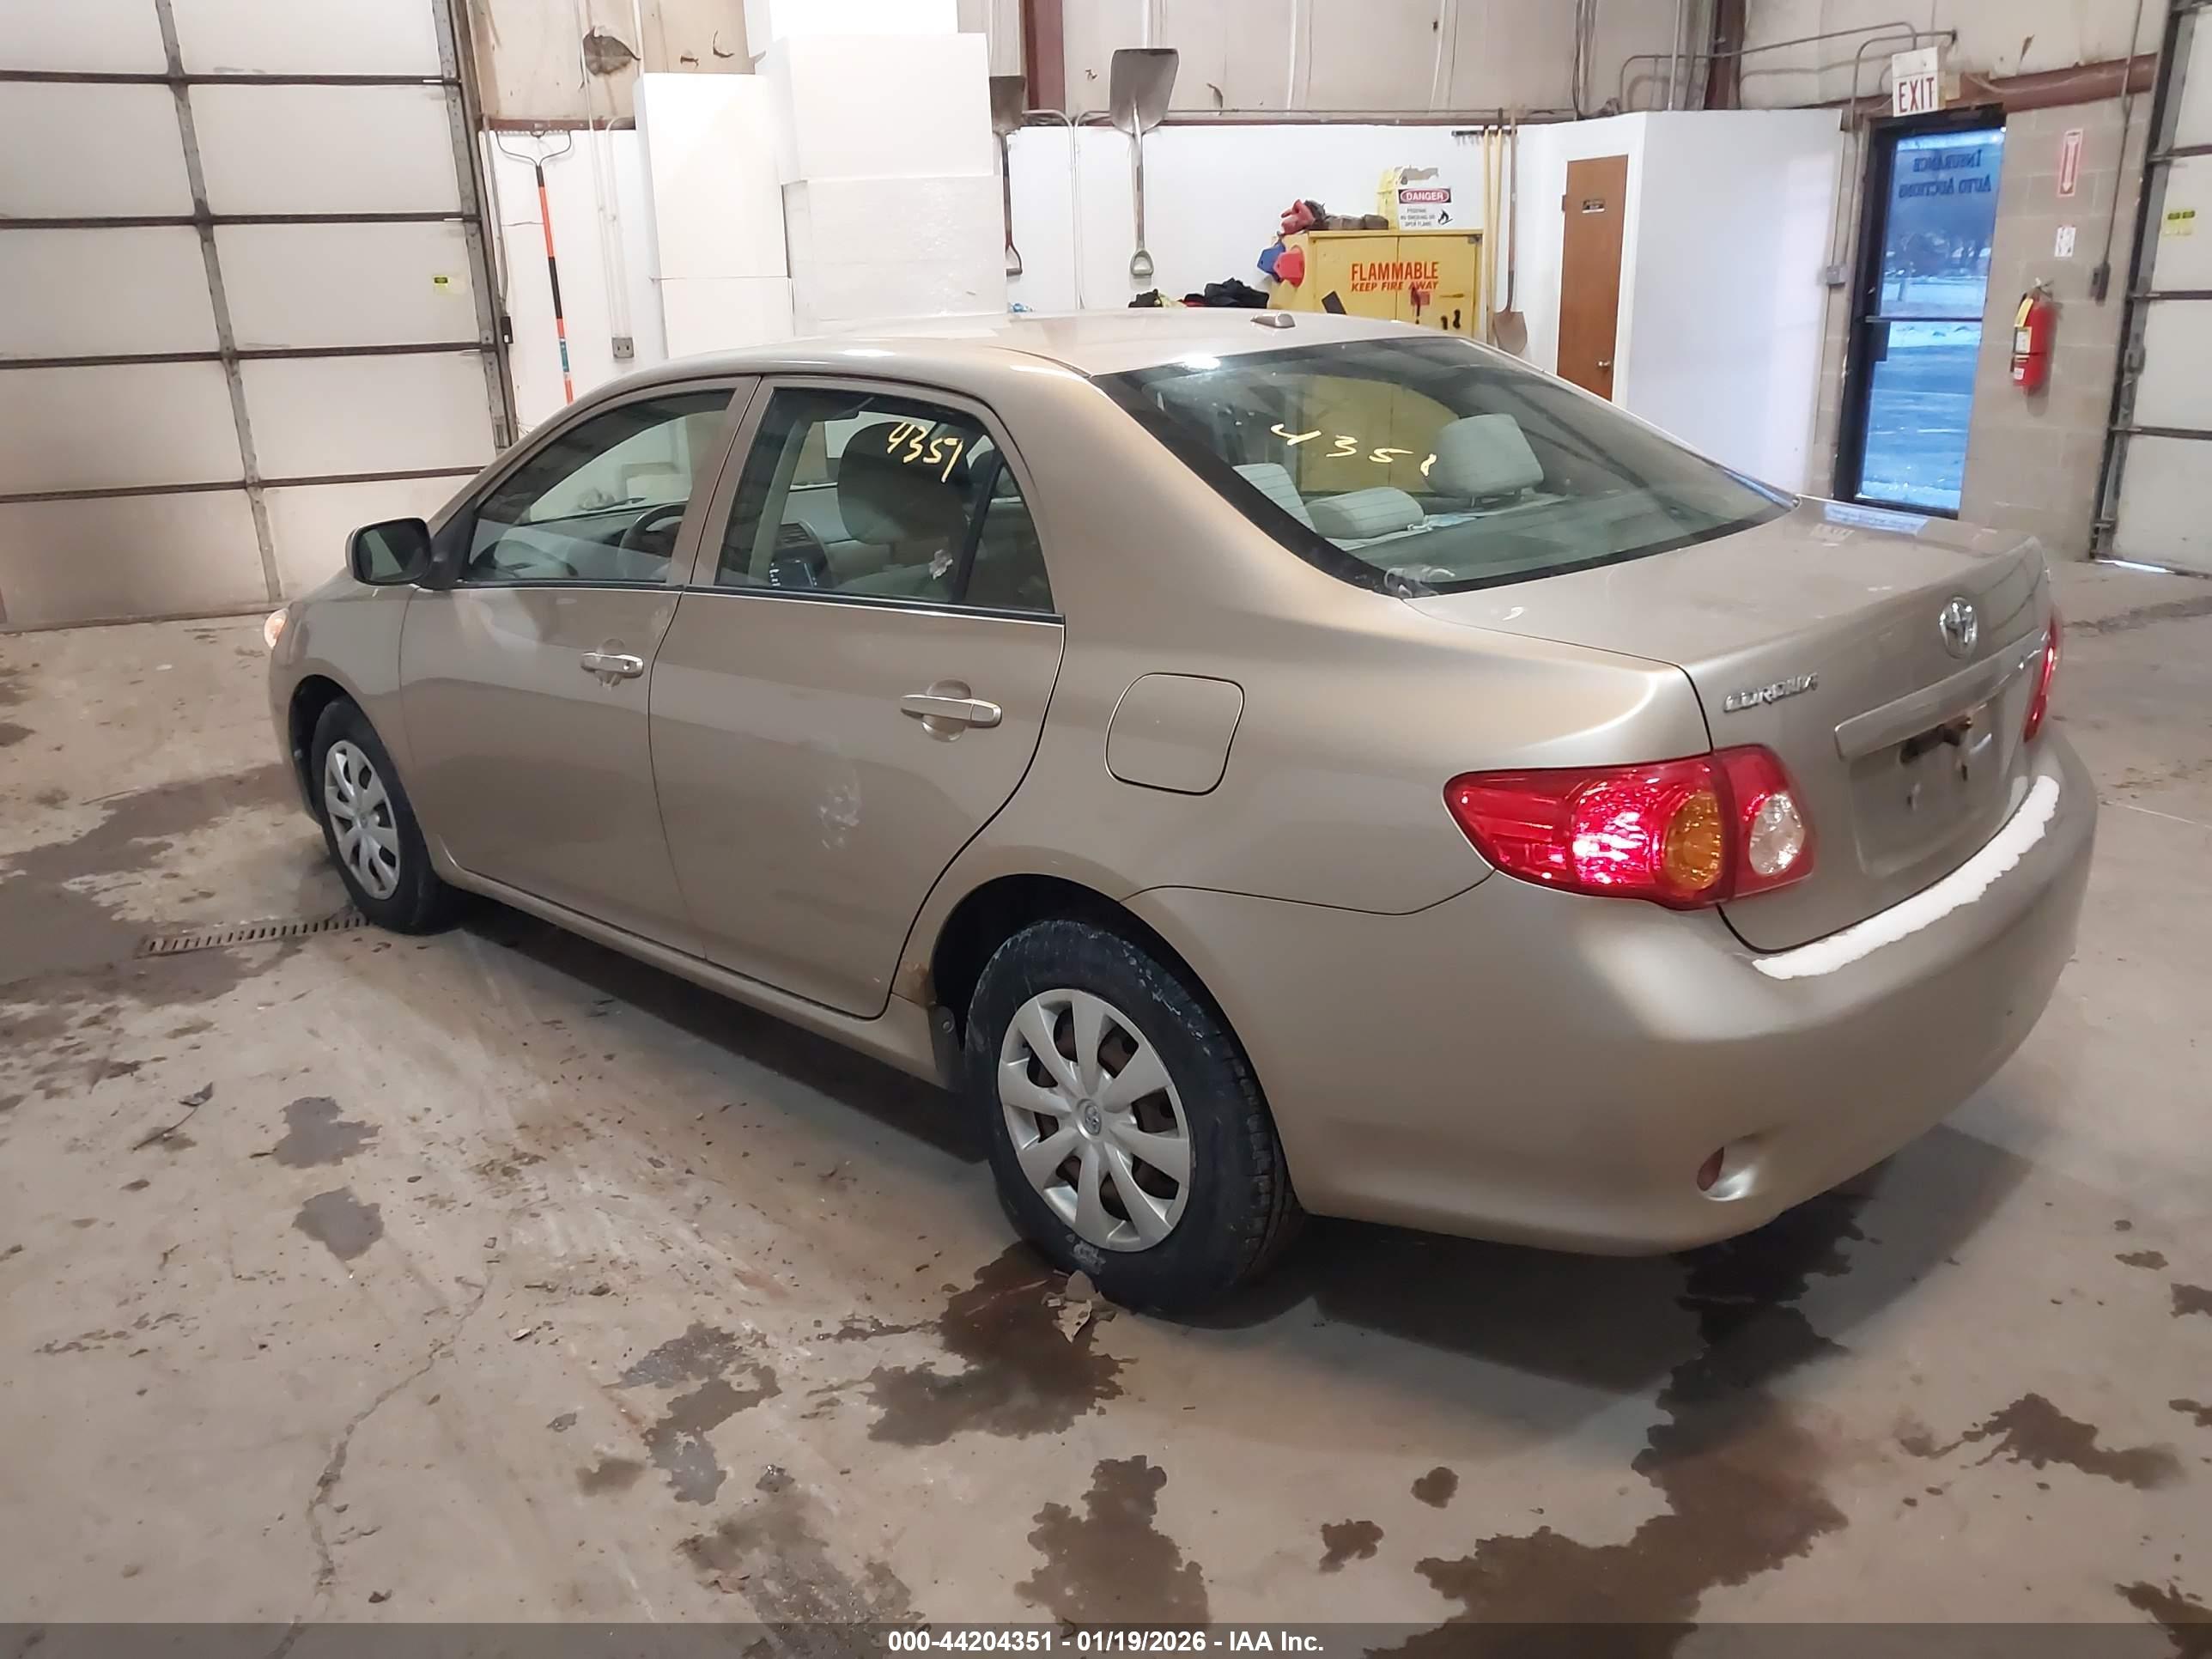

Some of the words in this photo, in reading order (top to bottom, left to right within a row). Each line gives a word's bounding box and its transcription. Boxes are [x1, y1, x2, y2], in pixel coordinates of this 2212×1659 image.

[1899, 77, 1934, 113] EXIT
[1406, 191, 1444, 201] DANGER
[1352, 261, 1439, 281] FLAMMABLE
[1352, 283, 1377, 292] KEEP
[1382, 282, 1403, 290] FIRE
[1408, 281, 1438, 290] AWAY
